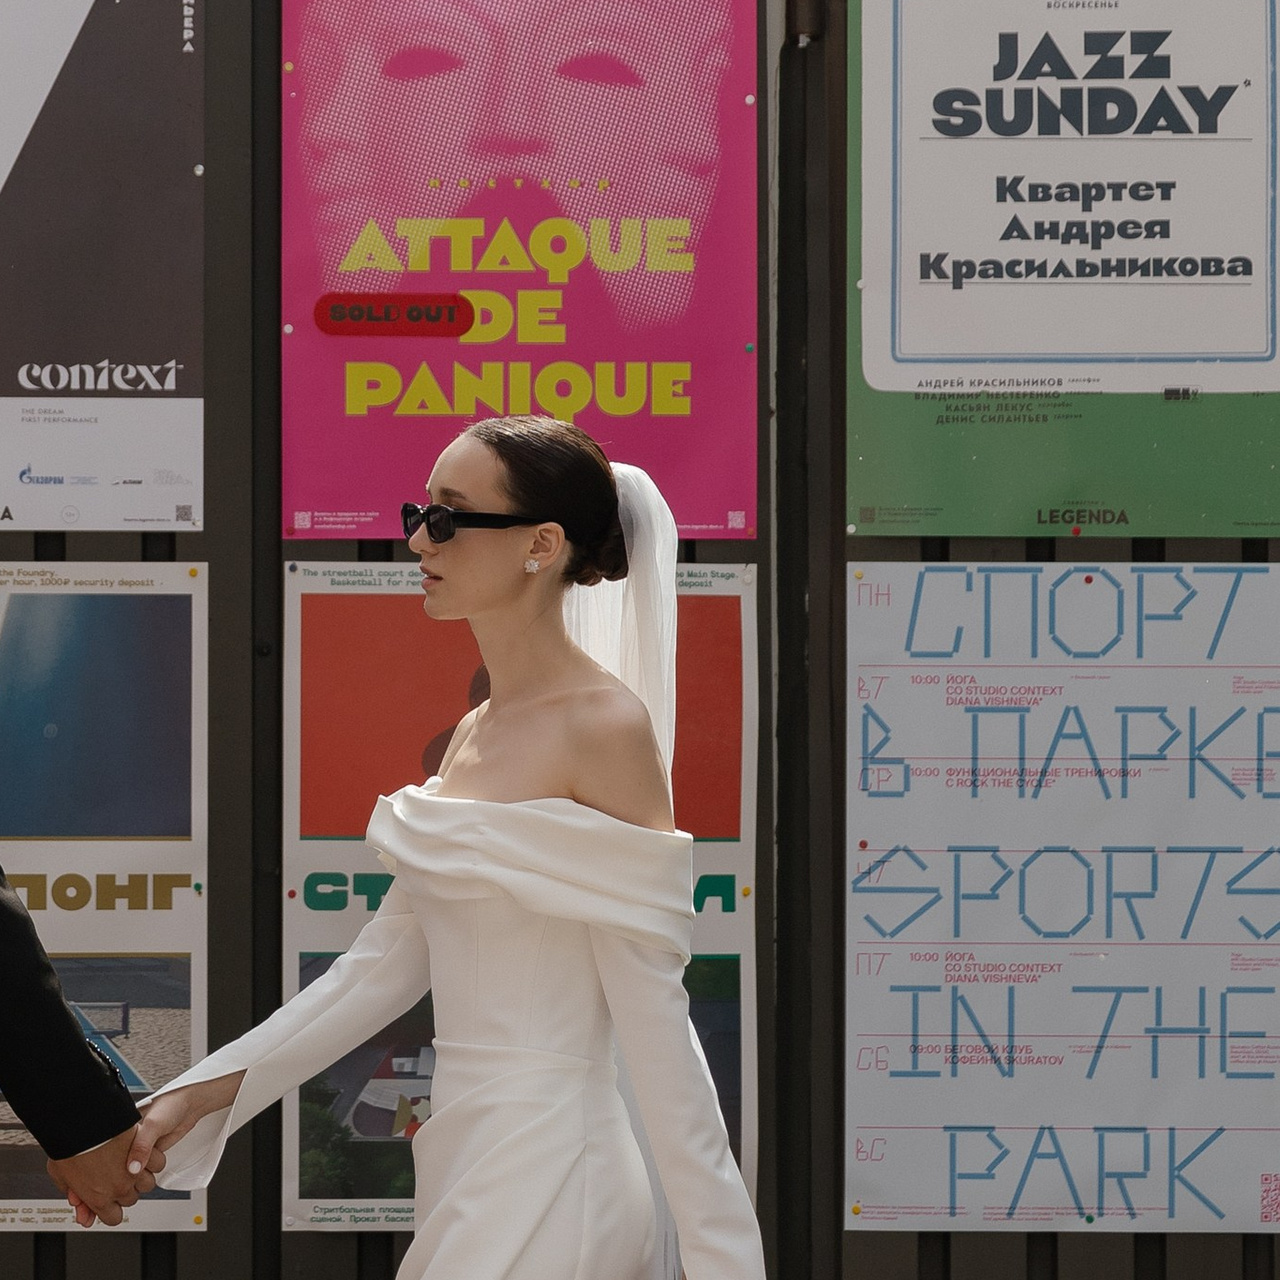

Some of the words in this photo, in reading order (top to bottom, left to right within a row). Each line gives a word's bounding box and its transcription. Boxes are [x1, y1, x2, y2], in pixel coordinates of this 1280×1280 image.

[1046, 1, 1120, 9] ВОСКРЕСЕНЬЕ
[992, 29, 1173, 82] JAZZ
[995, 175, 1177, 212] Квартет
[999, 213, 1171, 250] Андрея
[338, 217, 695, 284] ATTAQUE
[919, 252, 1253, 289] Красильникова
[328, 304, 401, 323] SOLD
[406, 303, 460, 323] OUT
[458, 289, 567, 344] DE
[17, 358, 184, 391] context
[917, 376, 964, 389] АНДРЕЙ
[969, 377, 1064, 388] КРАСИЛЬНИКОВ
[345, 361, 692, 422] PANIQUE
[913, 391, 981, 402] ВЛАДИМИР
[986, 390, 1061, 400] НЕСТЕРЕНКО
[945, 402, 991, 412] КАСЬЯН
[996, 402, 1034, 412] ЛЕКУС
[935, 414, 976, 425] ДЕНИС
[980, 413, 1049, 424] СИЛАНТЬЕВ
[1037, 508, 1130, 525] LEGENDA
[303, 568, 319, 577] The
[322, 568, 374, 577] streetball
[377, 568, 404, 577] court
[330, 578, 382, 587] Basketball
[387, 578, 401, 587] for
[857, 583, 891, 606] ПН
[904, 565, 1270, 659] СПОРТ
[857, 675, 891, 700] ВТ
[910, 675, 941, 684] 10:00
[946, 673, 977, 685] ЙОГА
[966, 685, 1007, 696] STUDIO
[1010, 685, 1065, 696] CONTEXT
[946, 696, 980, 707] DIANA
[862, 703, 912, 798] В
[857, 767, 893, 792] СР
[910, 767, 940, 777] 10:00
[945, 767, 1061, 778] ФУНКЦИОНАЛЬНЫЕ
[1065, 767, 1142, 778] ТРЕНИРОВКИ
[945, 778, 954, 788] С
[957, 778, 988, 788] ROCK
[992, 778, 1013, 788] THE
[857, 860, 892, 884] ЧТ
[856, 952, 892, 976] ПТ
[909, 952, 939, 962] 10:00
[945, 950, 976, 962] ЙОГА
[945, 973, 979, 984] DIANA
[964, 963, 1005, 973] STUDIO
[1008, 963, 1063, 973] CONTEXT
[889, 985, 1015, 1078] IN
[1071, 985, 1276, 1079] THE
[857, 1045, 890, 1071] СБ
[909, 1044, 941, 1054] 09:00
[945, 1043, 999, 1055] БЕГОВОЙ
[1002, 1044, 1034, 1055] КЛУБ
[945, 1054, 1001, 1066] КОФЕЙНИ
[1004, 1055, 1065, 1066] SKURATOV
[856, 1137, 887, 1162] ВС
[943, 1125, 1226, 1219] PARK
